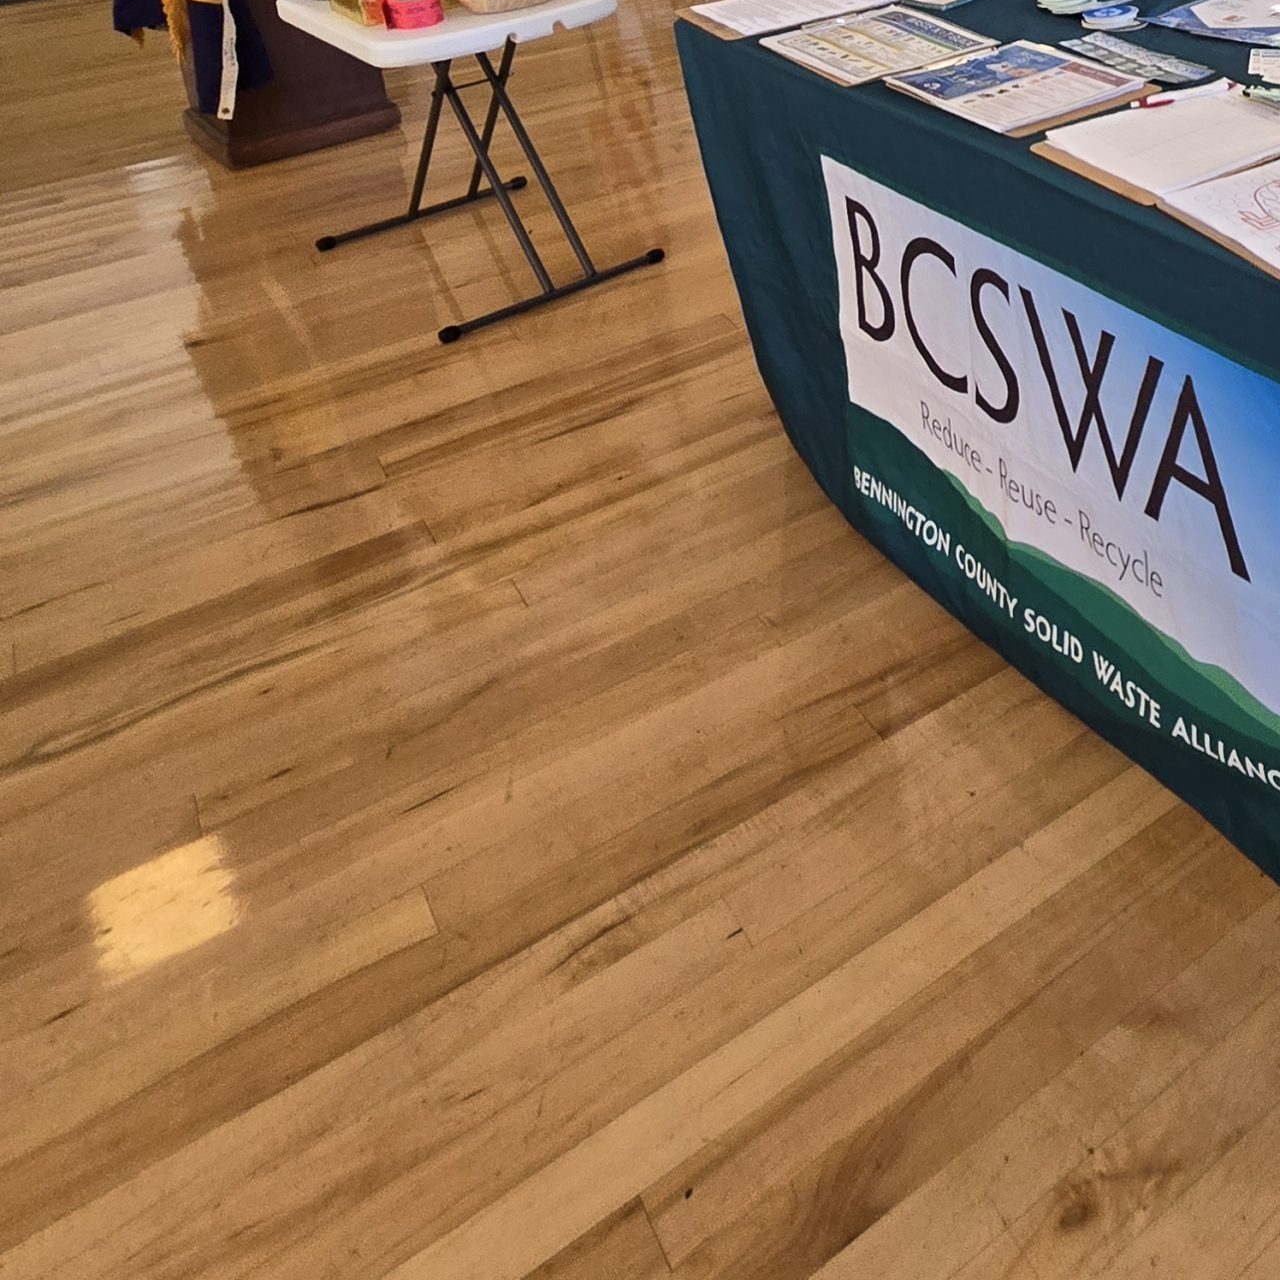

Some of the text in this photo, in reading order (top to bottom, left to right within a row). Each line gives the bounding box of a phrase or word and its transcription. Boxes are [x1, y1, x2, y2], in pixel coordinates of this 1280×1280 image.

[845, 197, 1251, 582] BCSWA
[920, 401, 983, 476] Reduce
[998, 459, 1057, 526] Reuse
[1079, 511, 1164, 597] Recycle
[853, 466, 951, 553] BENNINGTON
[956, 545, 1018, 619] COUNTY
[1024, 608, 1084, 664] SOLID
[1093, 651, 1161, 728] WASTE
